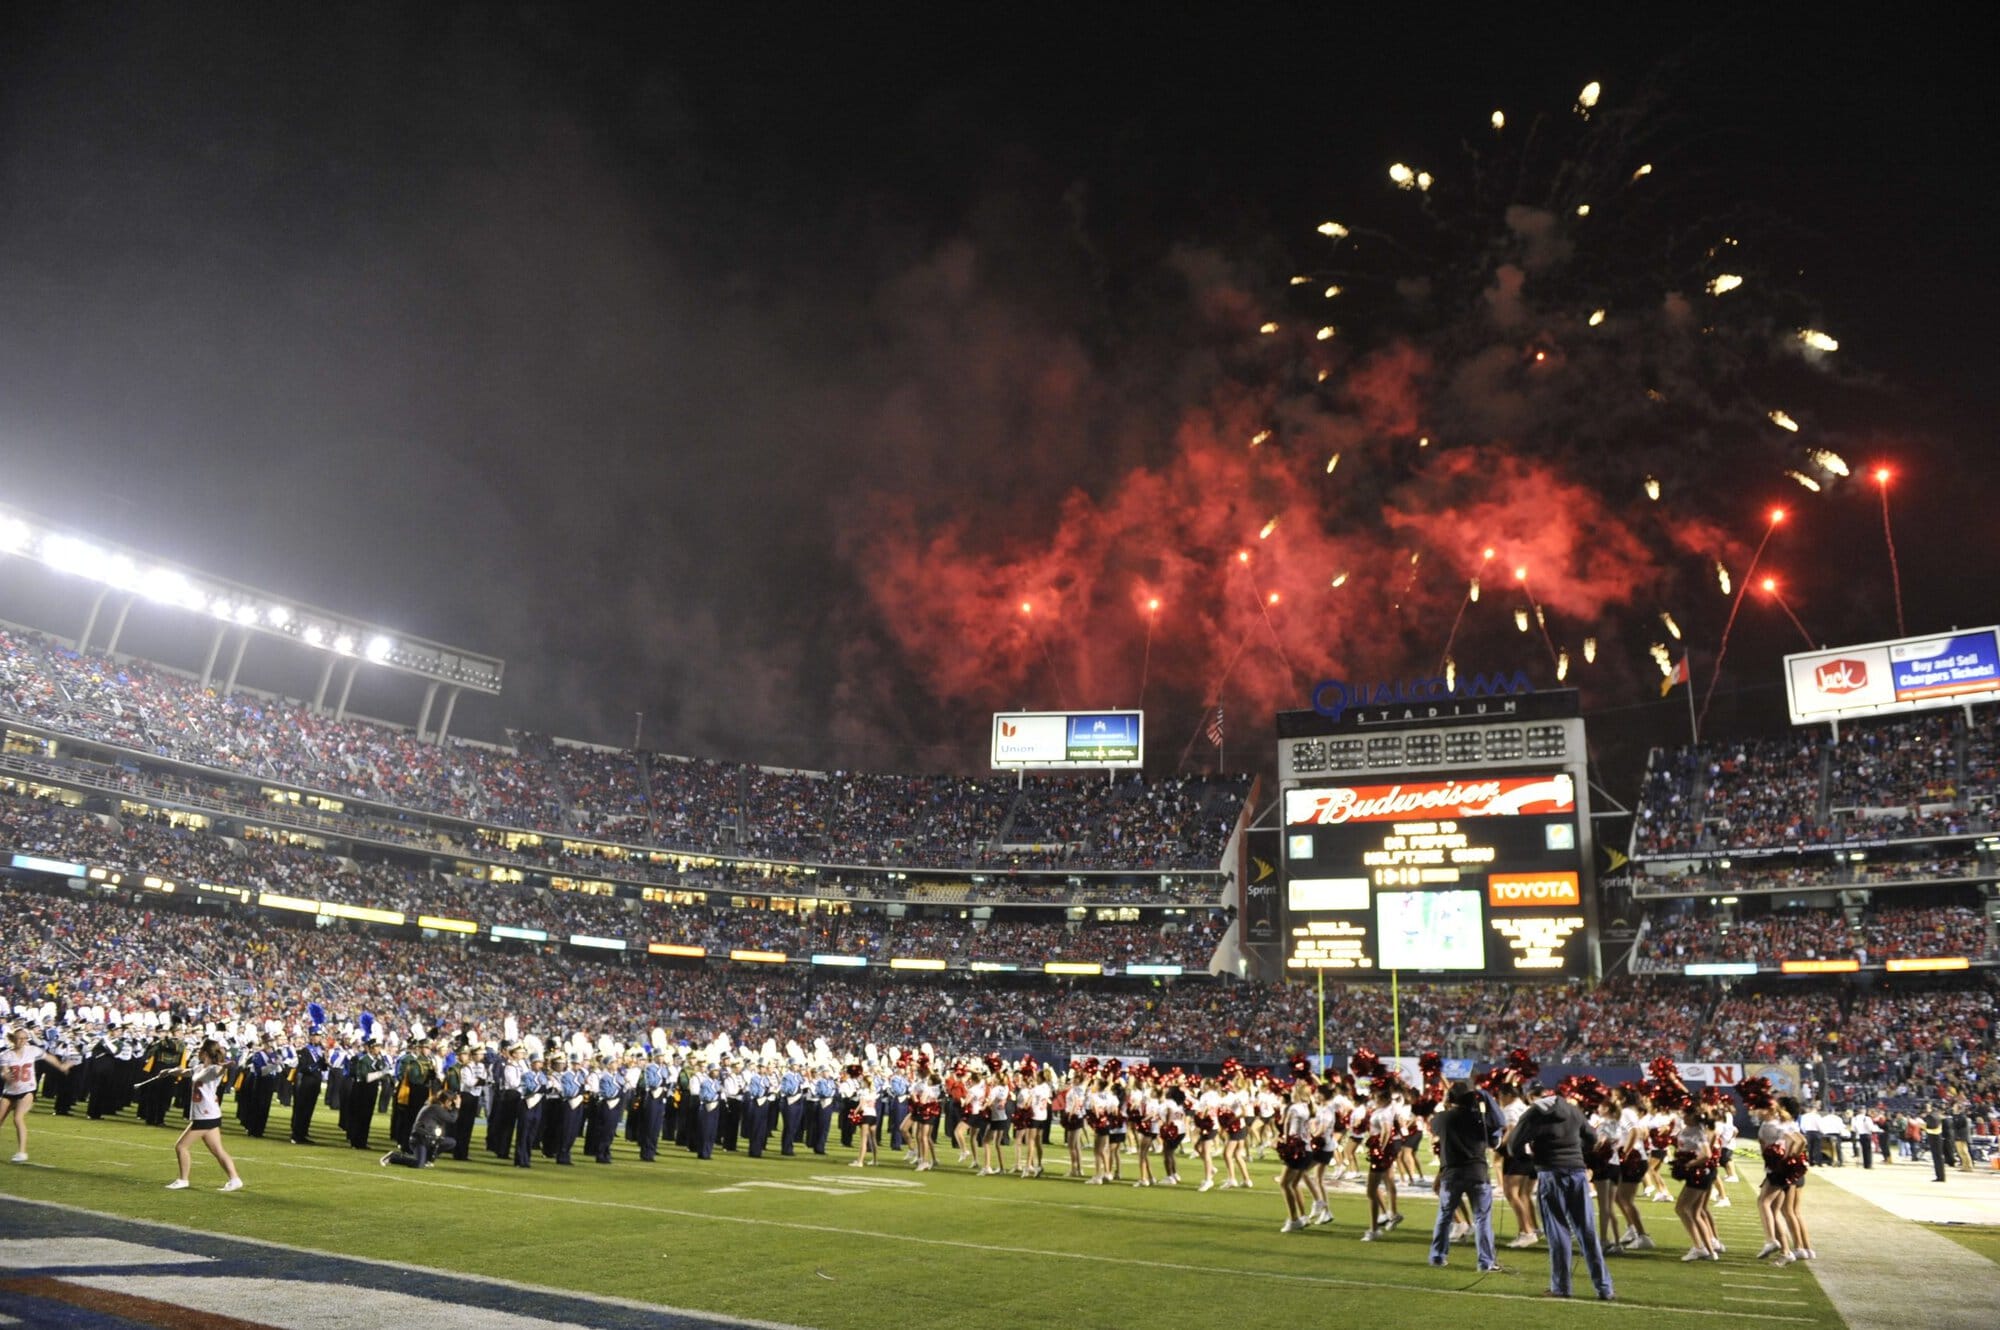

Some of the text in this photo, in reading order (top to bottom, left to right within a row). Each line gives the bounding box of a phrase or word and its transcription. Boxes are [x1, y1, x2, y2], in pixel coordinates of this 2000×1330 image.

[1911, 653, 1978, 673] Buy and Sell
[1817, 660, 1867, 692] Jack
[1358, 701, 1516, 723] STADIUM
[1001, 744, 1034, 753] Union
[1316, 780, 1500, 824] Budweiser
[1247, 884, 1277, 897] Sprint
[1492, 880, 1575, 900] TOYOTA
[1713, 1066, 1734, 1084] N
